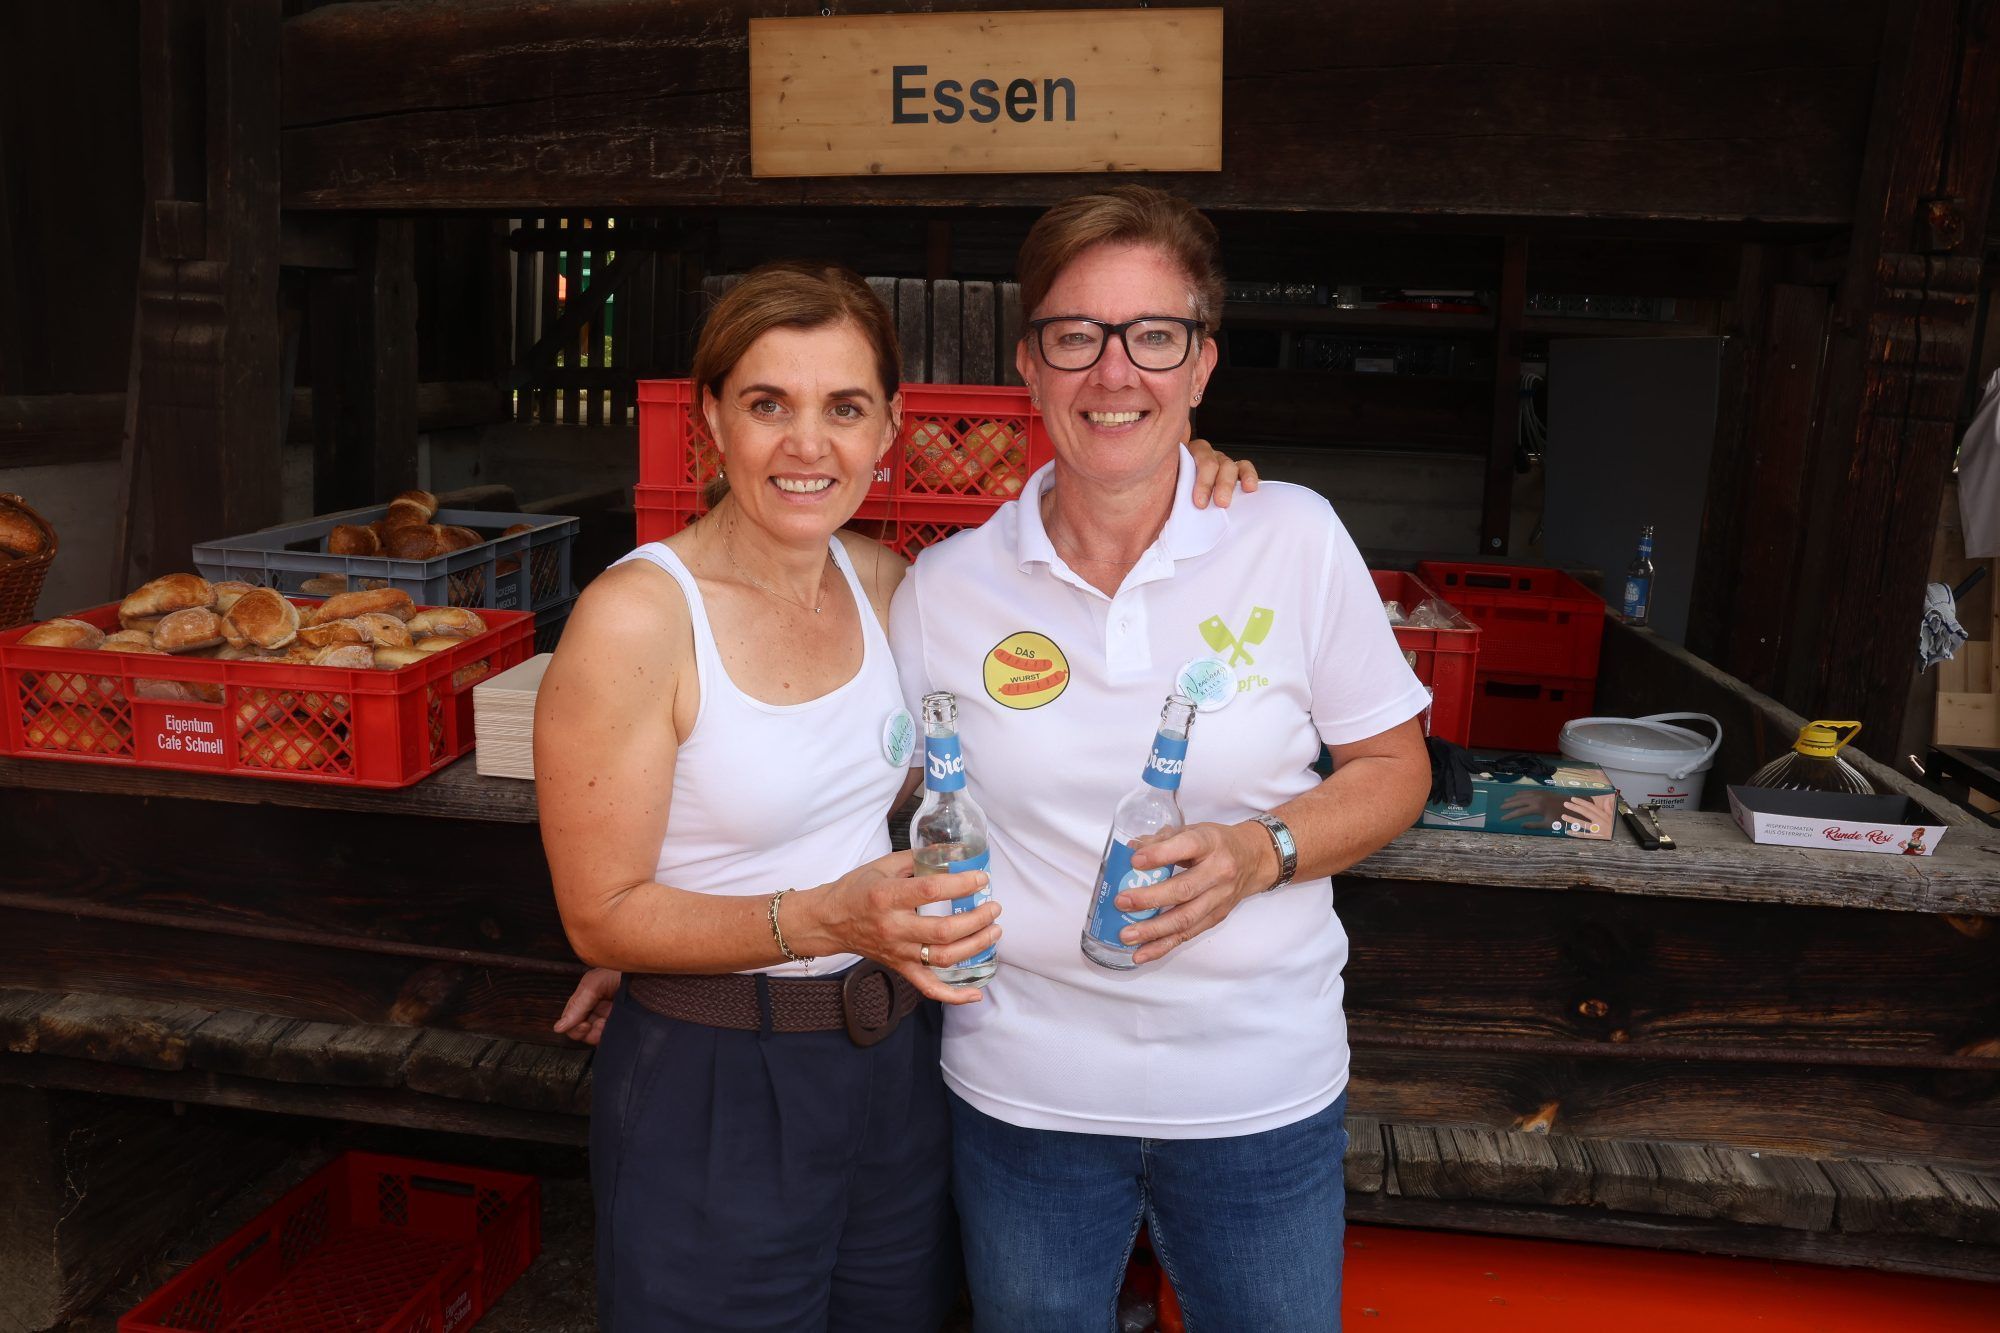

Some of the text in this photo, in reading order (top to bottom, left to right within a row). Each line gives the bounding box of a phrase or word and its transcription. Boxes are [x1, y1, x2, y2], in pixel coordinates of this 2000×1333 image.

[892, 65, 1076, 124] Essen
[1015, 646, 1035, 659] DAS
[1009, 673, 1040, 683] WURST
[165, 714, 213, 734] Eigentum
[157, 733, 182, 751] Cafe
[185, 735, 224, 755] Schnell
[1822, 826, 1894, 845] Runde Resi
